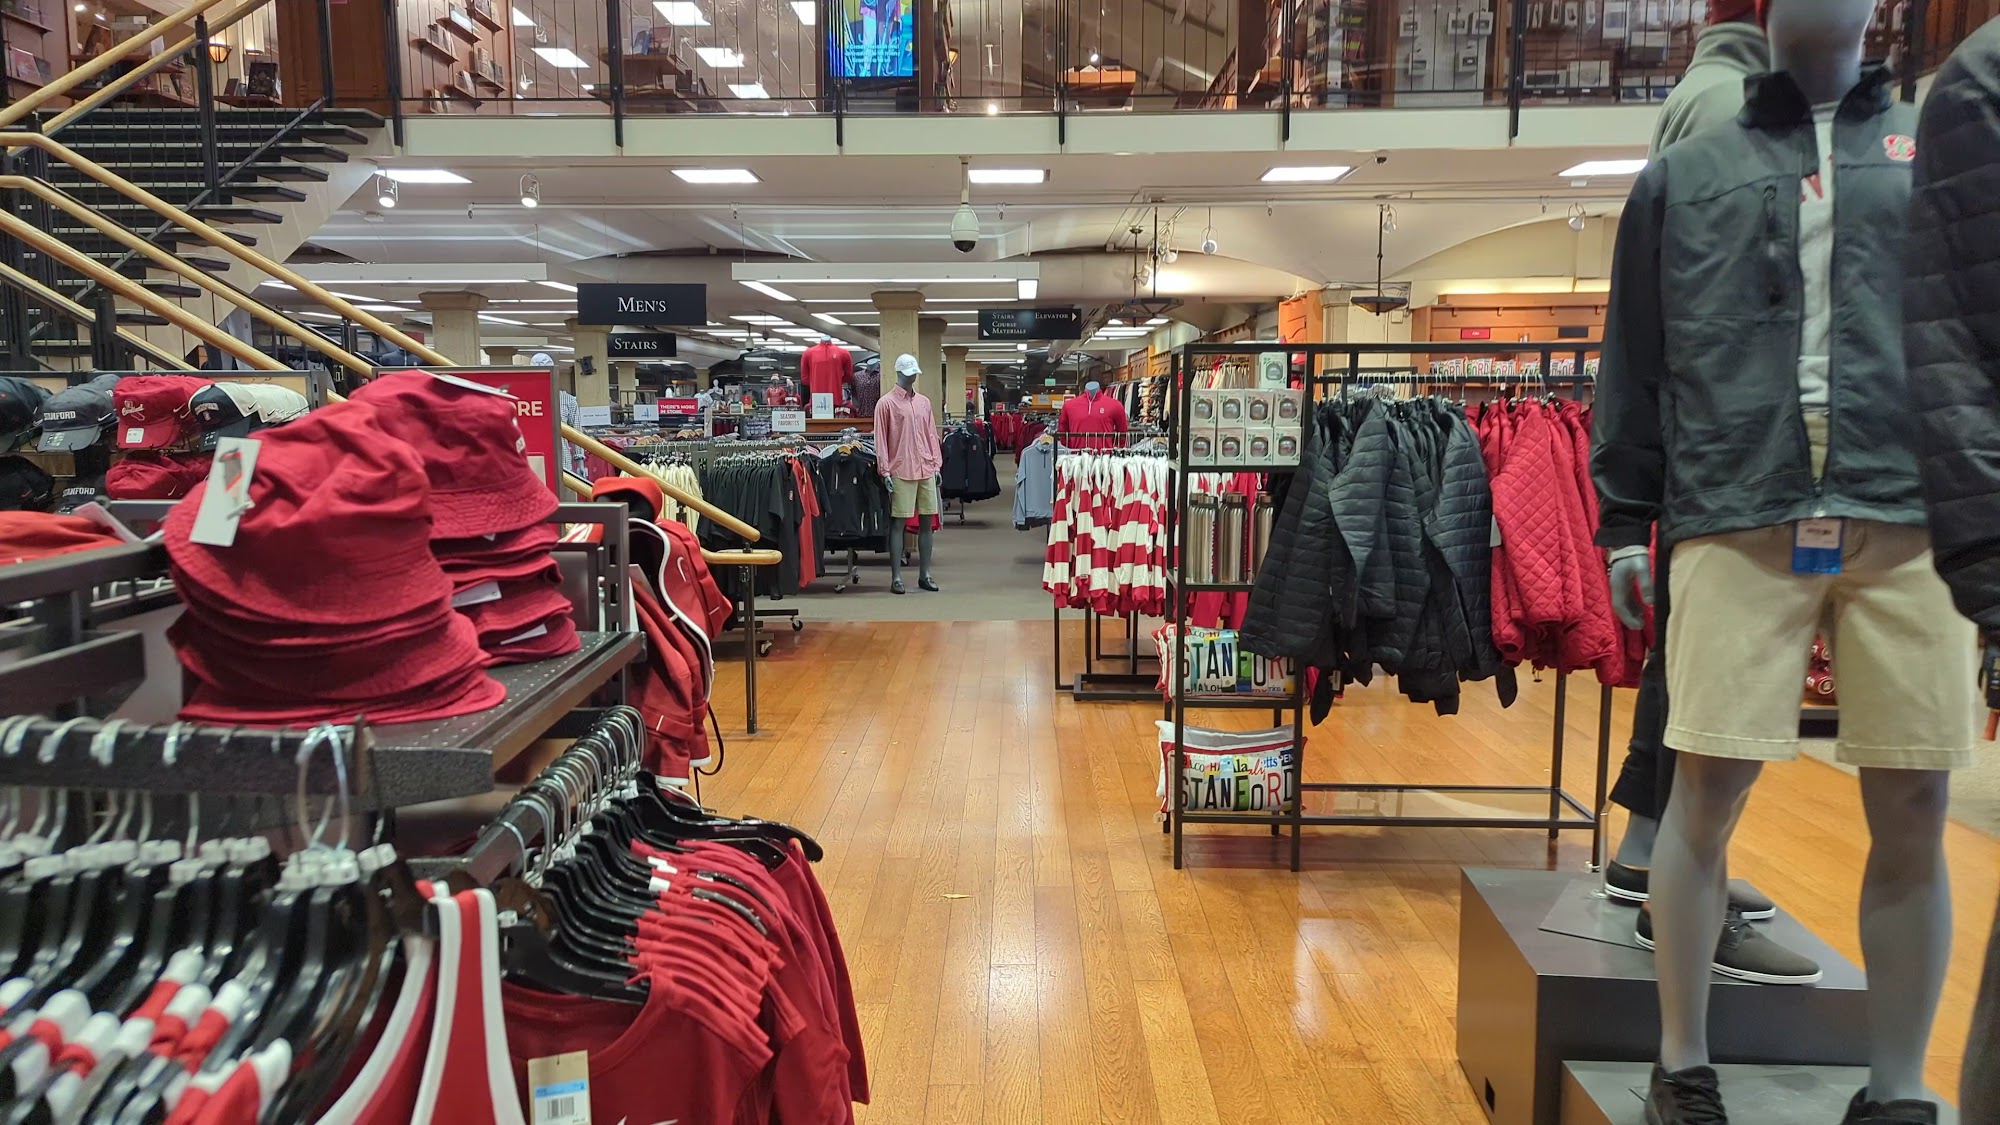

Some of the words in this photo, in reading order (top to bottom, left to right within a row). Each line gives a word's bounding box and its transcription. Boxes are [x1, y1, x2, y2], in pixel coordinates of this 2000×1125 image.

[617, 296, 667, 313] MEN'S
[614, 338, 658, 350] STAIRS
[43, 411, 76, 420] STANFORD
[62, 487, 96, 498] STANFORD
[1181, 768, 1293, 812] STANFORD
